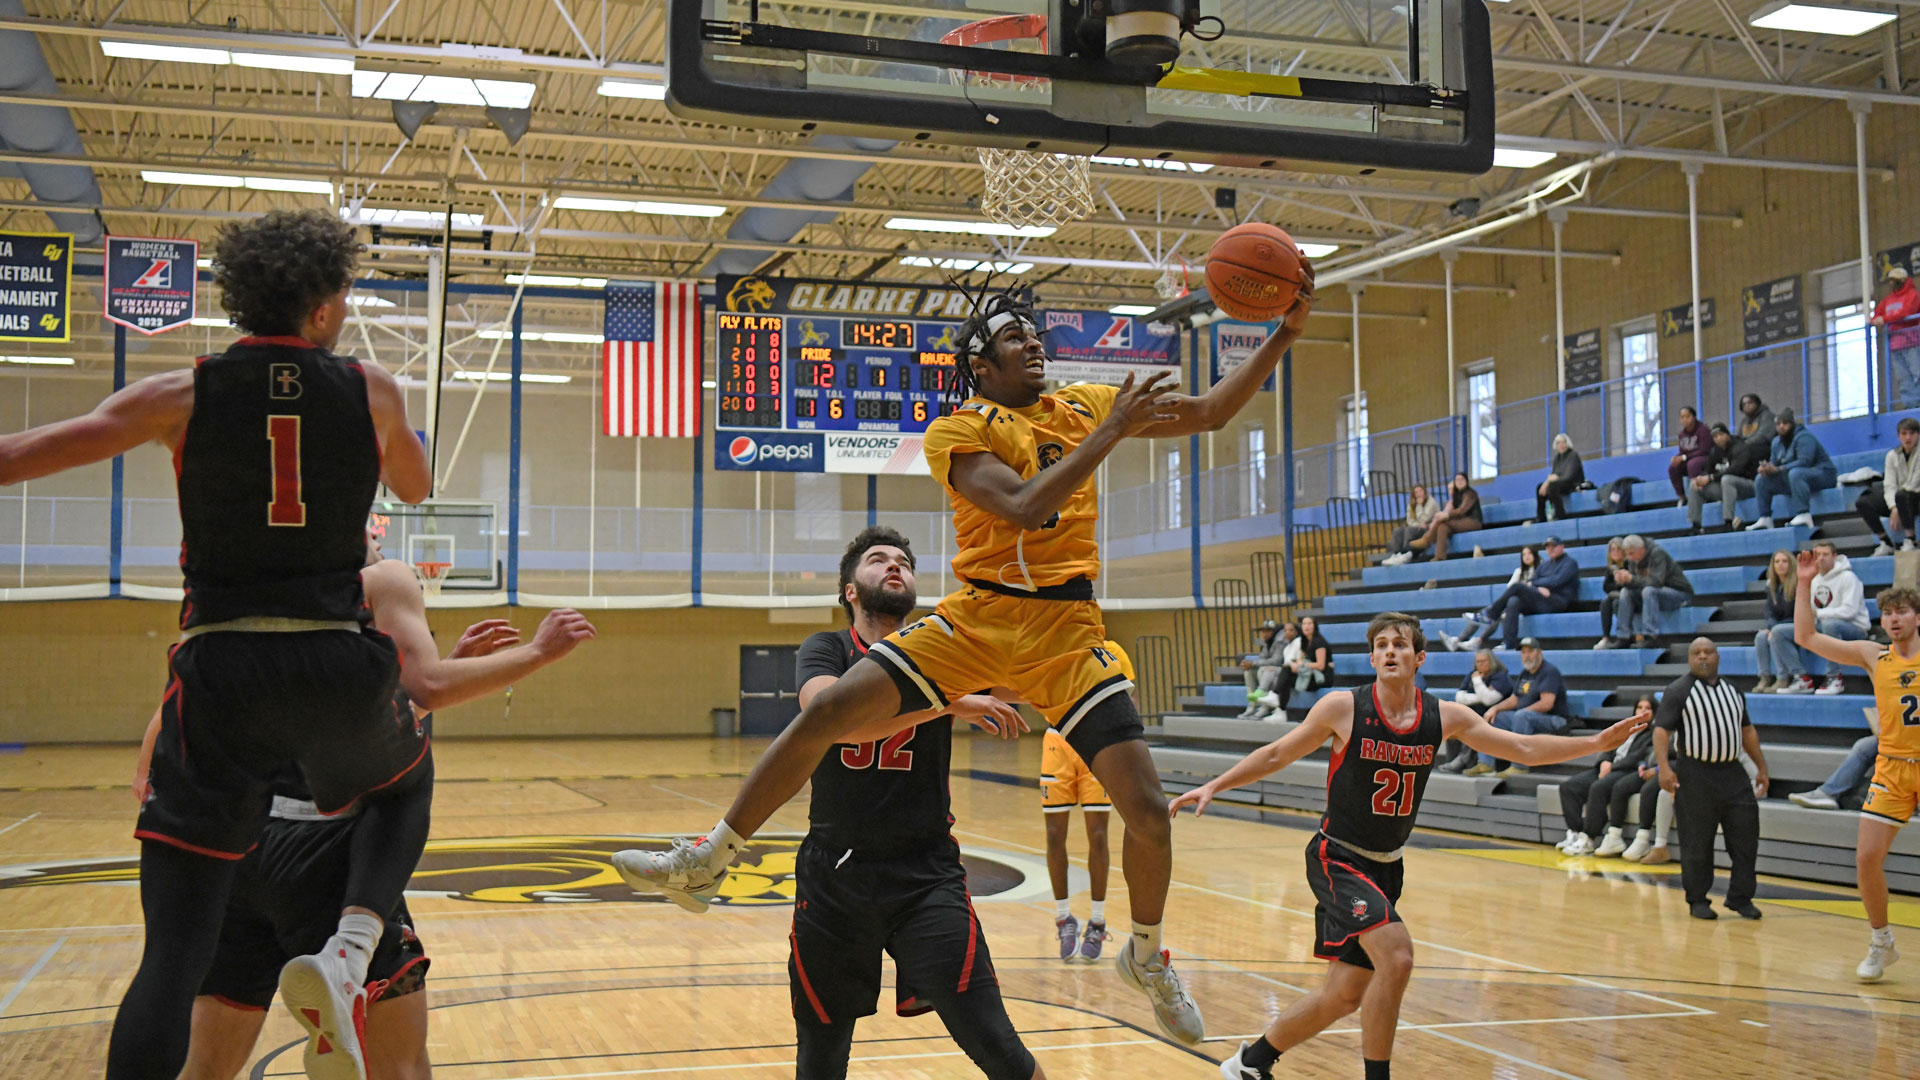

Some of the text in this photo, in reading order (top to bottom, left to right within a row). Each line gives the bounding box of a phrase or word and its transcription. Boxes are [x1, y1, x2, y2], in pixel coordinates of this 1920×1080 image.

[43, 244, 63, 261] CU
[121, 249, 180, 260] BASKETBALL
[114, 298, 188, 310] CONFERENCE
[789, 284, 919, 315] CLARKE
[121, 305, 180, 317] CHAMPION
[40, 314, 61, 331] CU
[138, 317, 163, 327] 2022
[720, 315, 781, 331] PLY FL PTS
[1048, 313, 1080, 326] NAIA
[736, 332, 780, 348] 1 1 8
[853, 323, 912, 348] 14:27
[1220, 334, 1264, 350] NAIA
[731, 347, 780, 363] 2 0 0
[801, 347, 832, 361] PRIDE
[920, 353, 957, 366] RAVENS
[1056, 346, 1097, 356] HEART
[1113, 349, 1168, 359] AMERICA
[865, 357, 892, 367] PERIOD
[733, 363, 780, 380] 3 0 0
[813, 363, 835, 388] 12
[878, 369, 885, 386] 1
[726, 379, 780, 396] 11 0 3
[794, 389, 819, 398] FOULS
[853, 391, 902, 400] PLAYER FOUL
[721, 396, 780, 412] 20 0 1
[809, 400, 815, 417] 1
[829, 399, 843, 419] 6
[913, 401, 927, 422] 6
[797, 421, 815, 430] WON
[858, 423, 899, 432] ADVANTAGE
[828, 437, 900, 449] VENDORS
[759, 442, 813, 461] pepsi
[837, 449, 892, 459] UNLIMITED
[267, 415, 306, 527] 1
[1360, 738, 1434, 766] RAVENS
[1371, 768, 1416, 817] 21
